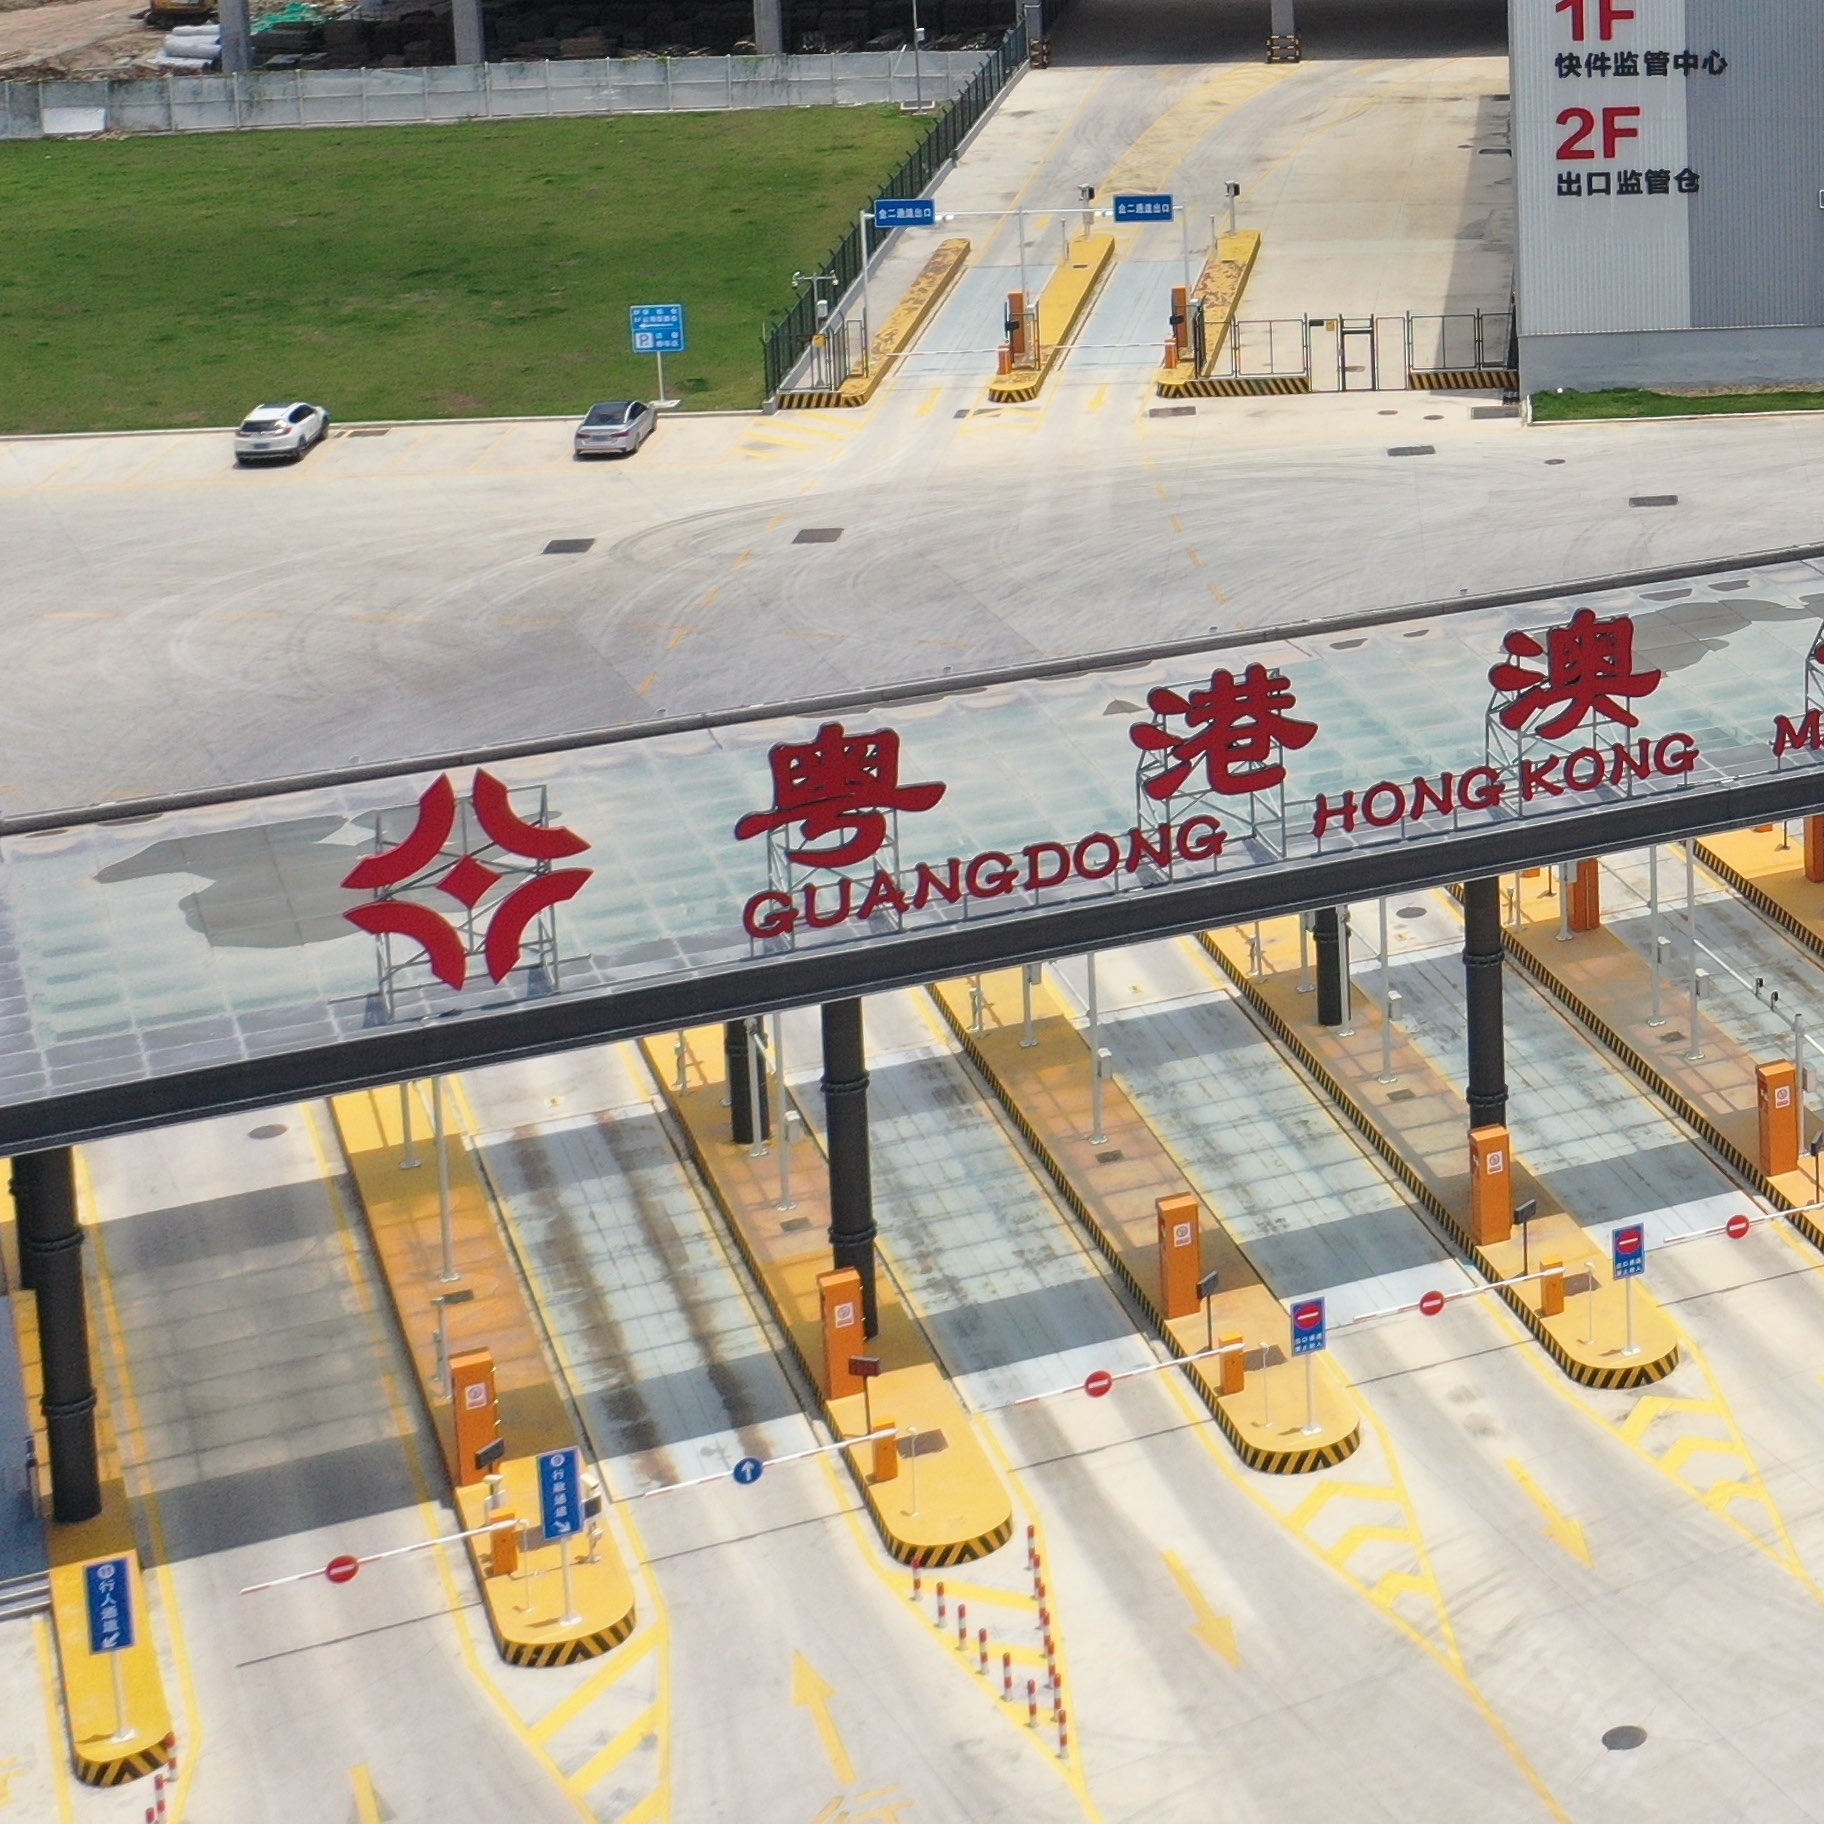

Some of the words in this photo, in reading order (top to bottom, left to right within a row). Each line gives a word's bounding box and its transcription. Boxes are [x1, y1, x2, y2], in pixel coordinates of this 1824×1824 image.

[1554, 48, 1729, 79] 快件监管中心
[1555, 106, 1641, 161] 2F
[1556, 165, 1701, 198] 出口监管仓
[741, 814, 1227, 940] GUANGDONG
[1314, 768, 1504, 838] HONG
[1521, 732, 1699, 802] KONG
